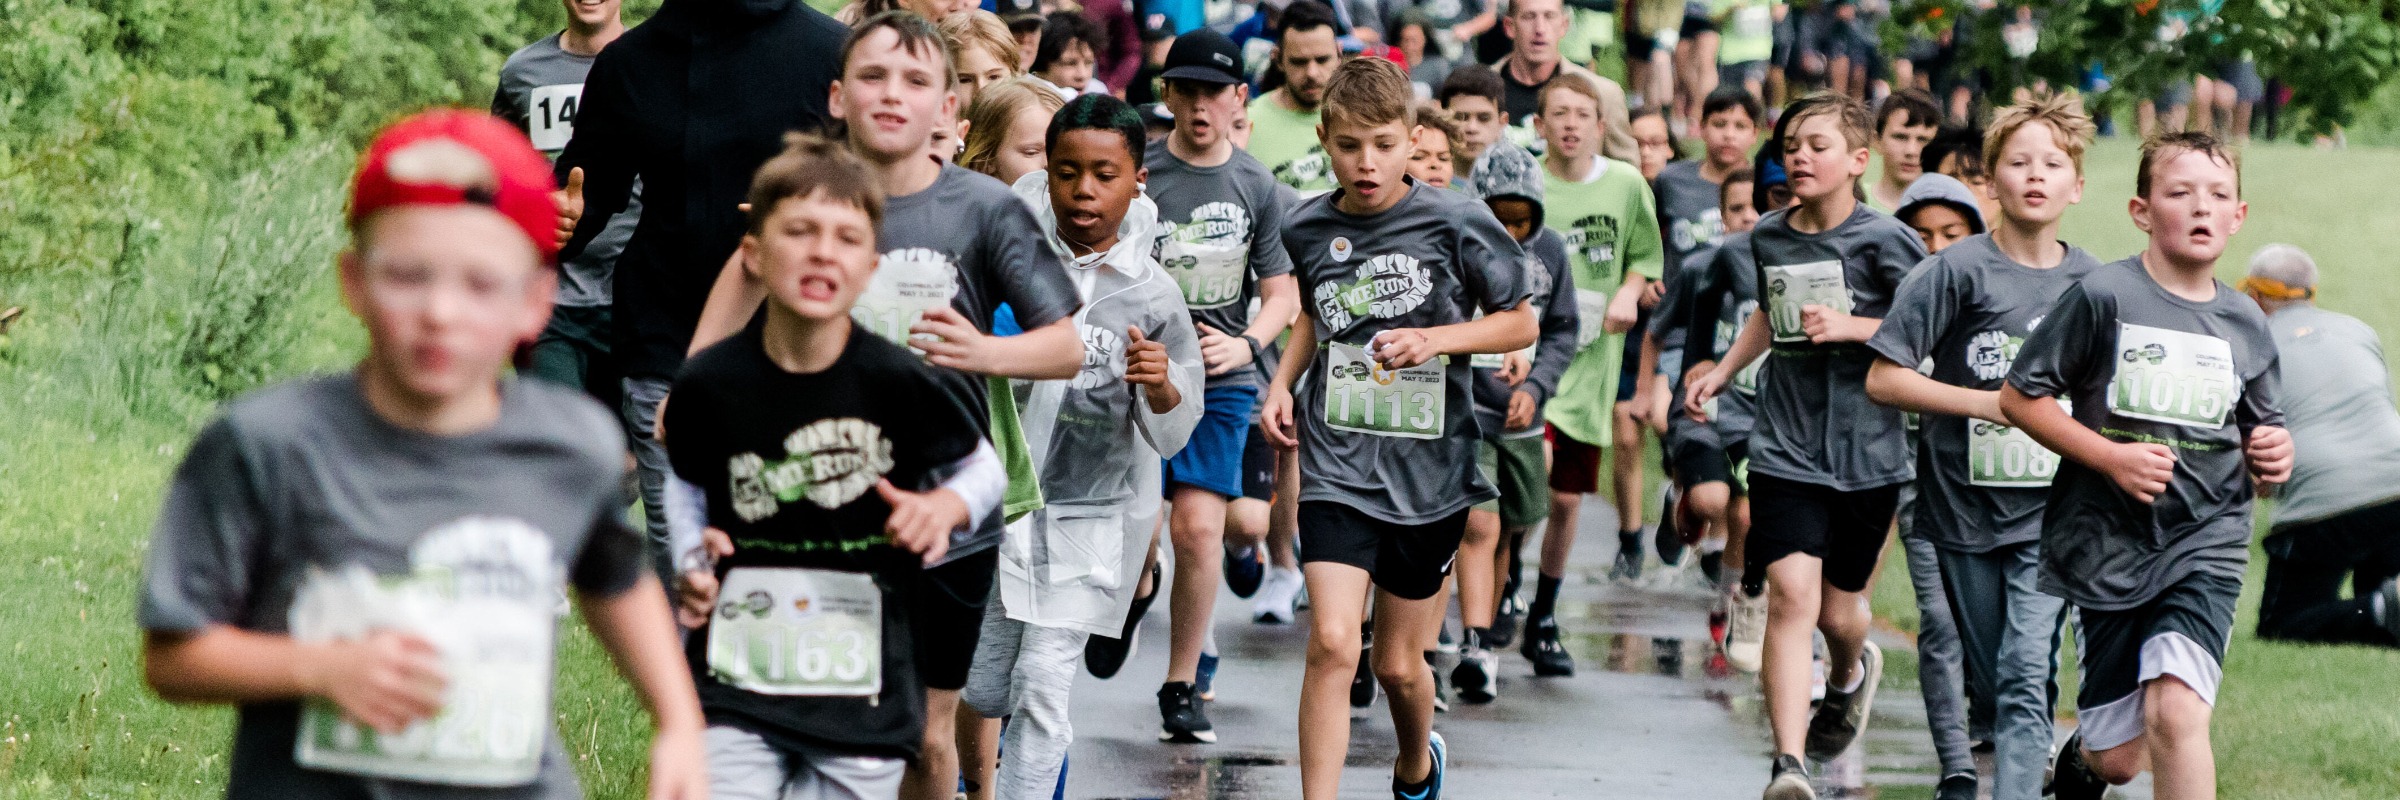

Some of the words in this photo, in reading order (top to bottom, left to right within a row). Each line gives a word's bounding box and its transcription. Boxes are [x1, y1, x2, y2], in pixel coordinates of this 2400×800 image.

[1178, 224, 1206, 241] ME
[1206, 220, 1238, 237] RUN
[1173, 271, 1240, 303] 156
[1341, 283, 1375, 308] ME
[1373, 276, 1410, 297] RUN
[1335, 384, 1435, 430] 1113
[2126, 368, 2223, 419] 1015
[1979, 439, 2058, 478] 108
[728, 628, 869, 683] 1163
